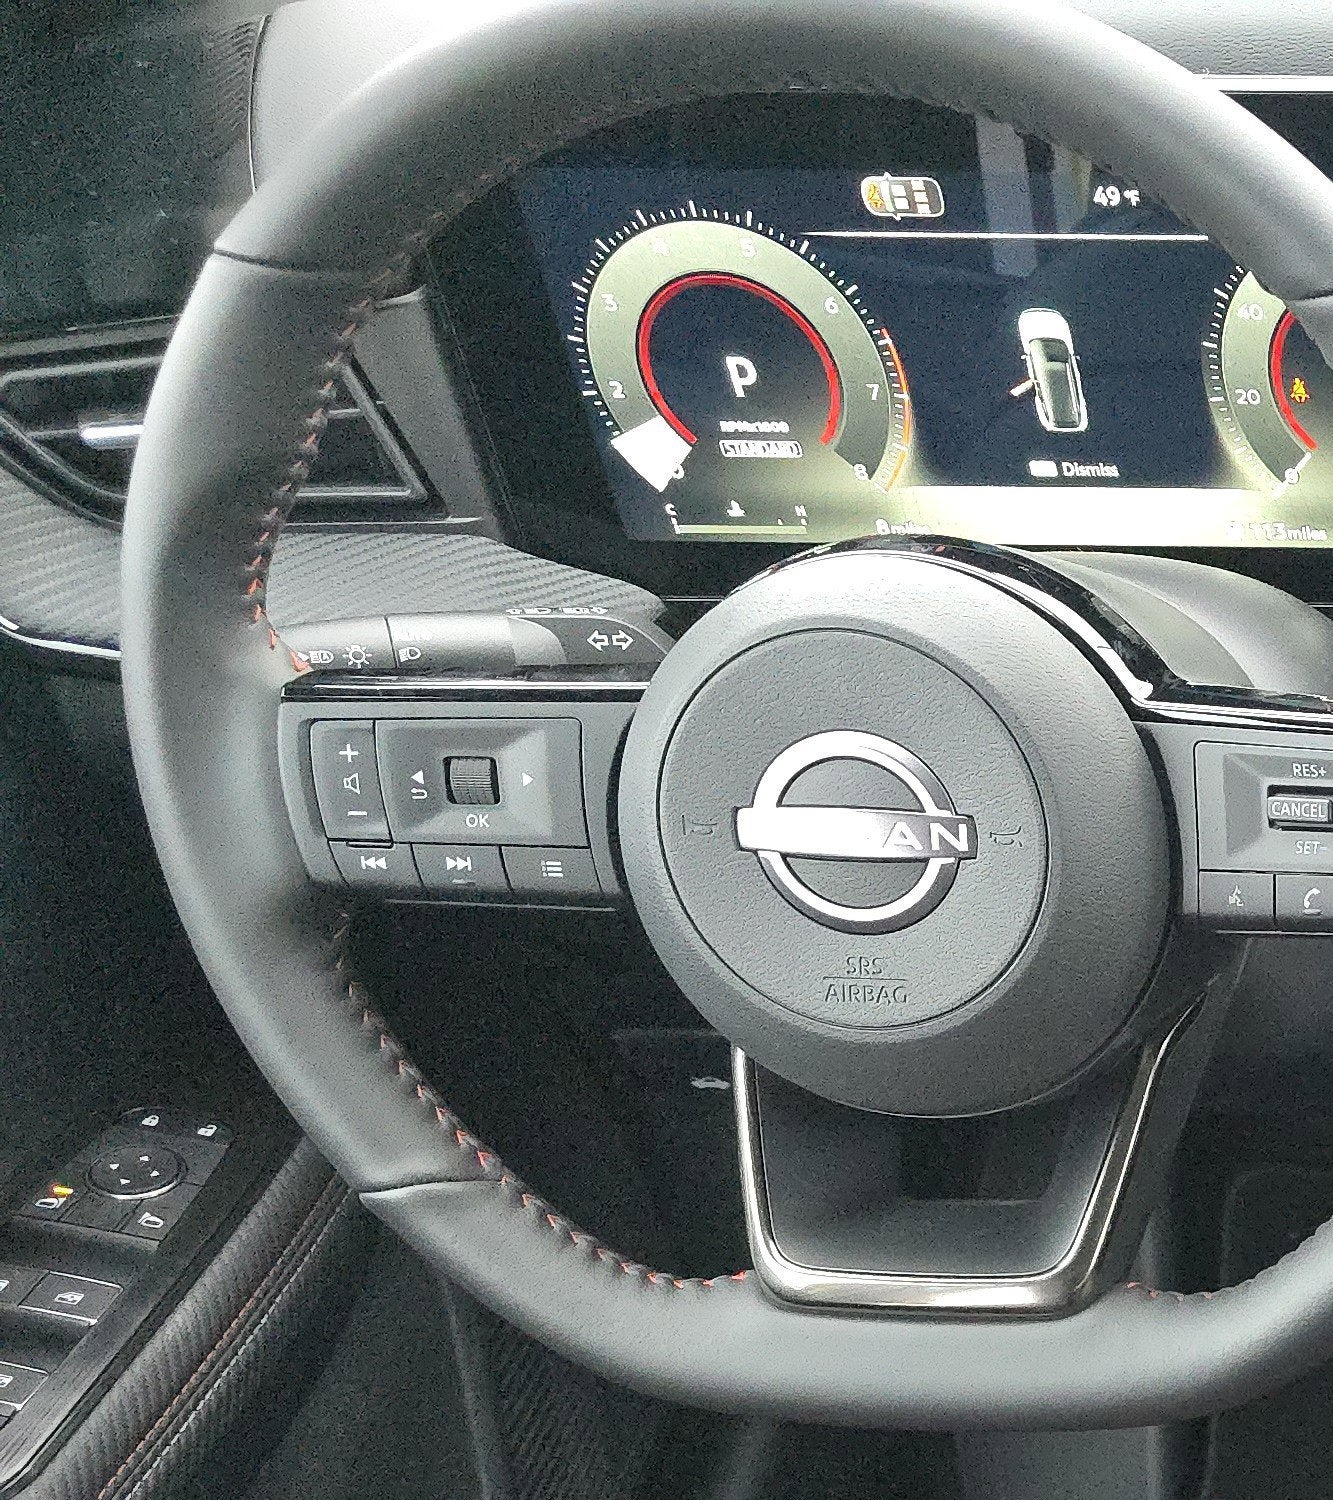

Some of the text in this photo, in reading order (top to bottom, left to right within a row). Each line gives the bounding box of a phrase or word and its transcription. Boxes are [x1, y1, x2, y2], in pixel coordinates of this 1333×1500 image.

[1093, 185, 1121, 207] 49
[739, 235, 757, 258] 5
[601, 293, 619, 312] 3
[823, 297, 840, 315] 6
[1236, 303, 1265, 320] 40
[725, 355, 758, 398] P
[608, 381, 626, 399] 2
[865, 382, 880, 400] 7
[1234, 388, 1261, 405] 20
[853, 463, 869, 482] 8
[1061, 461, 1120, 478] Dismiss
[1286, 525, 1328, 541] miles
[1271, 801, 1326, 818] CANCEL
[465, 813, 490, 828] OK
[845, 955, 885, 976] SRS
[823, 983, 909, 1004] AIRBAG
